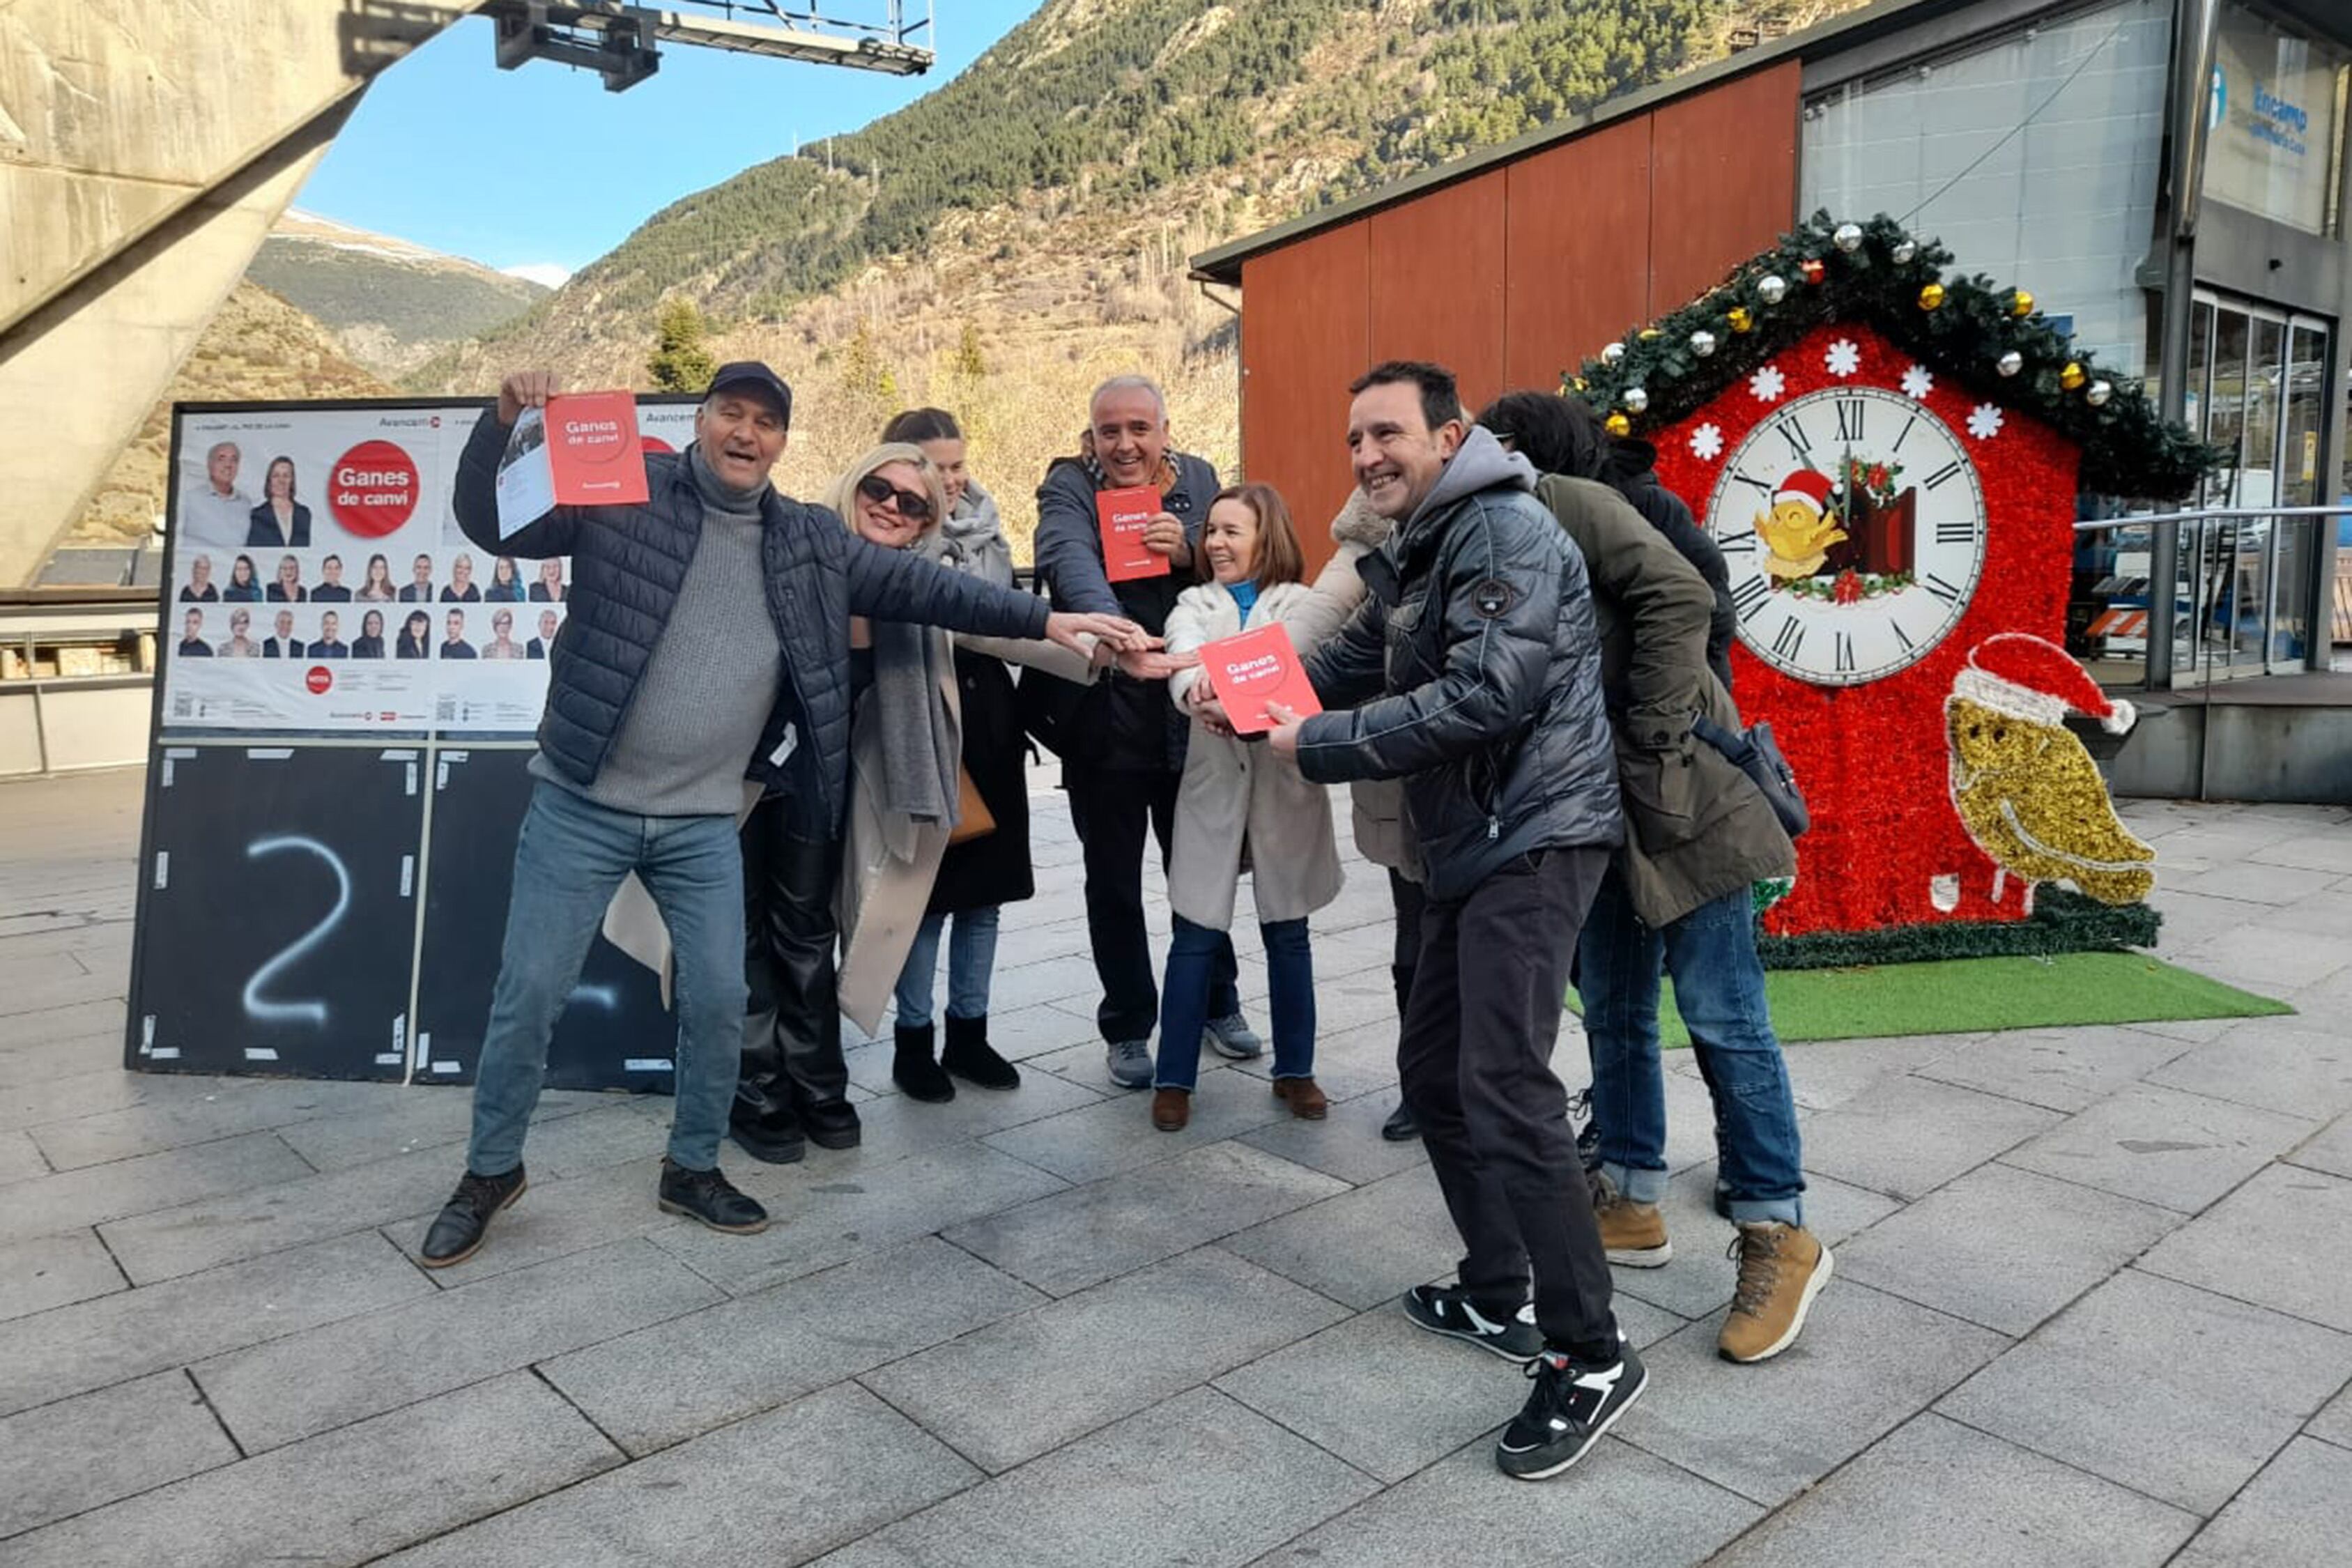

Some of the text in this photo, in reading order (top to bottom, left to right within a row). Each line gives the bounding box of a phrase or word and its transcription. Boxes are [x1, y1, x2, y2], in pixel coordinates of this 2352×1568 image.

[565, 420, 618, 433] Ganes
[1834, 399, 1865, 442] XII
[339, 468, 409, 486] Ganes
[338, 490, 409, 506] de canvi
[1937, 523, 1974, 544] III
[1227, 654, 1277, 675] Ganes
[243, 836, 351, 1020] 2
